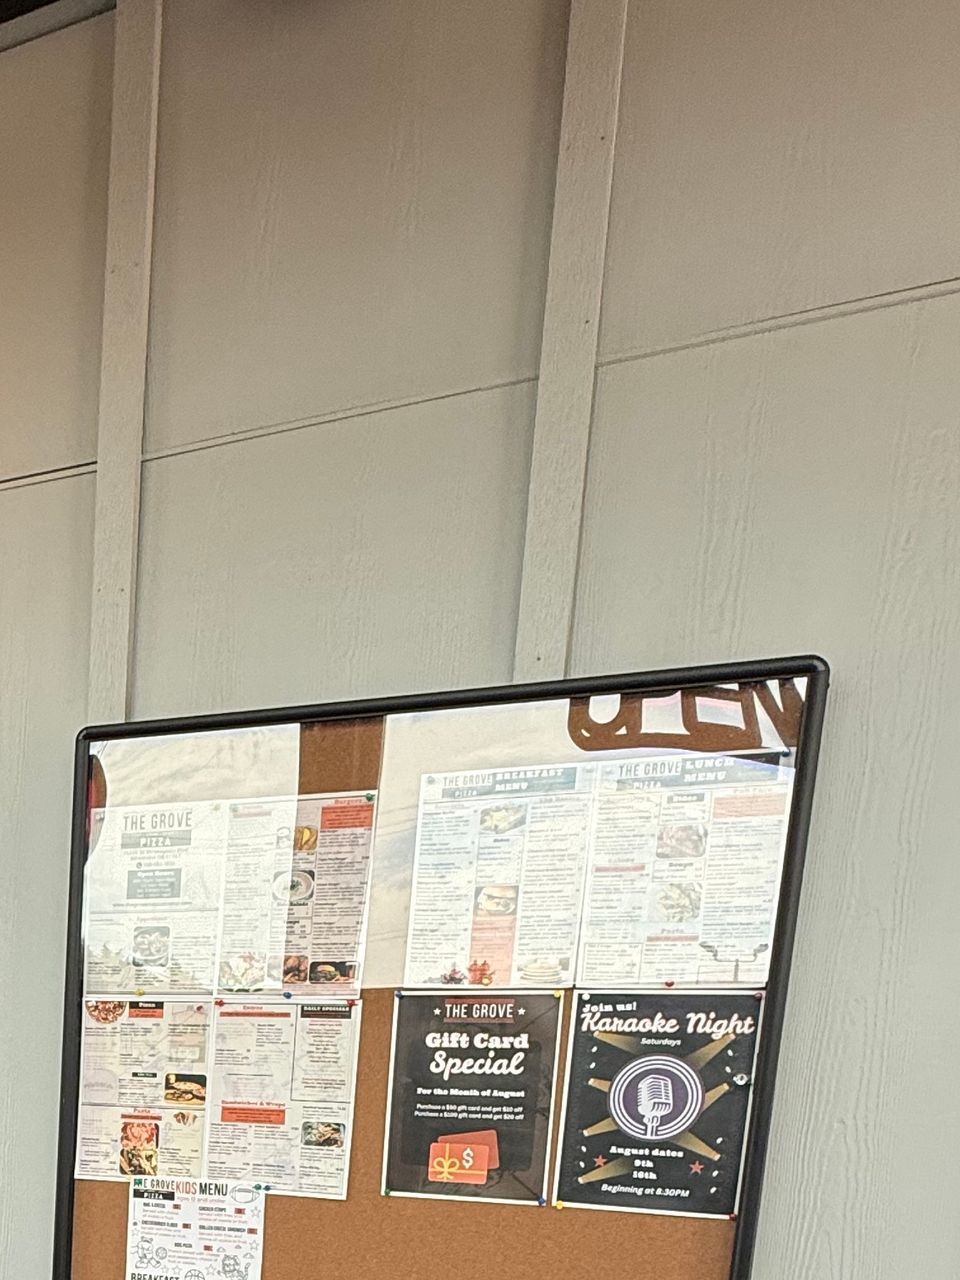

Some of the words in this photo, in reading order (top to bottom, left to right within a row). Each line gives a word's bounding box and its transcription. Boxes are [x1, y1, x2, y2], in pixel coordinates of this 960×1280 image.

[619, 763, 640, 777] THE
[644, 760, 680, 776] GROVE
[685, 758, 736, 769] LUNCH
[443, 776, 459, 787] THE
[462, 774, 492, 786] GROVE
[495, 768, 564, 781] BREAKFAST
[683, 771, 728, 783] MENU
[495, 782, 529, 792] MENU
[123, 815, 146, 832] THE
[151, 811, 193, 829] GROVE
[140, 836, 172, 847] PIZZA
[445, 1003, 468, 1019] THE
[472, 1003, 514, 1019] GROVE
[582, 1002, 614, 1014] Join
[616, 1001, 637, 1012] us!
[580, 1012, 680, 1034] Karaoke
[685, 1011, 756, 1041] Night
[425, 1032, 470, 1049] Gift
[473, 1033, 530, 1049] Card
[640, 1037, 682, 1047] Saturdays
[429, 1050, 526, 1081] Special
[416, 1087, 433, 1095] For
[433, 1087, 449, 1096] the
[449, 1088, 480, 1097] Month
[480, 1088, 492, 1097] of
[492, 1089, 525, 1099] August
[609, 1145, 650, 1156] August
[651, 1148, 684, 1158] dates
[633, 1159, 654, 1168] 9th
[632, 1170, 658, 1180] 16th
[150, 1179, 176, 1191] GROVE
[175, 1181, 198, 1195] KIDS
[199, 1182, 228, 1197] MENU
[601, 1183, 644, 1196] Beginning
[644, 1187, 655, 1195] at
